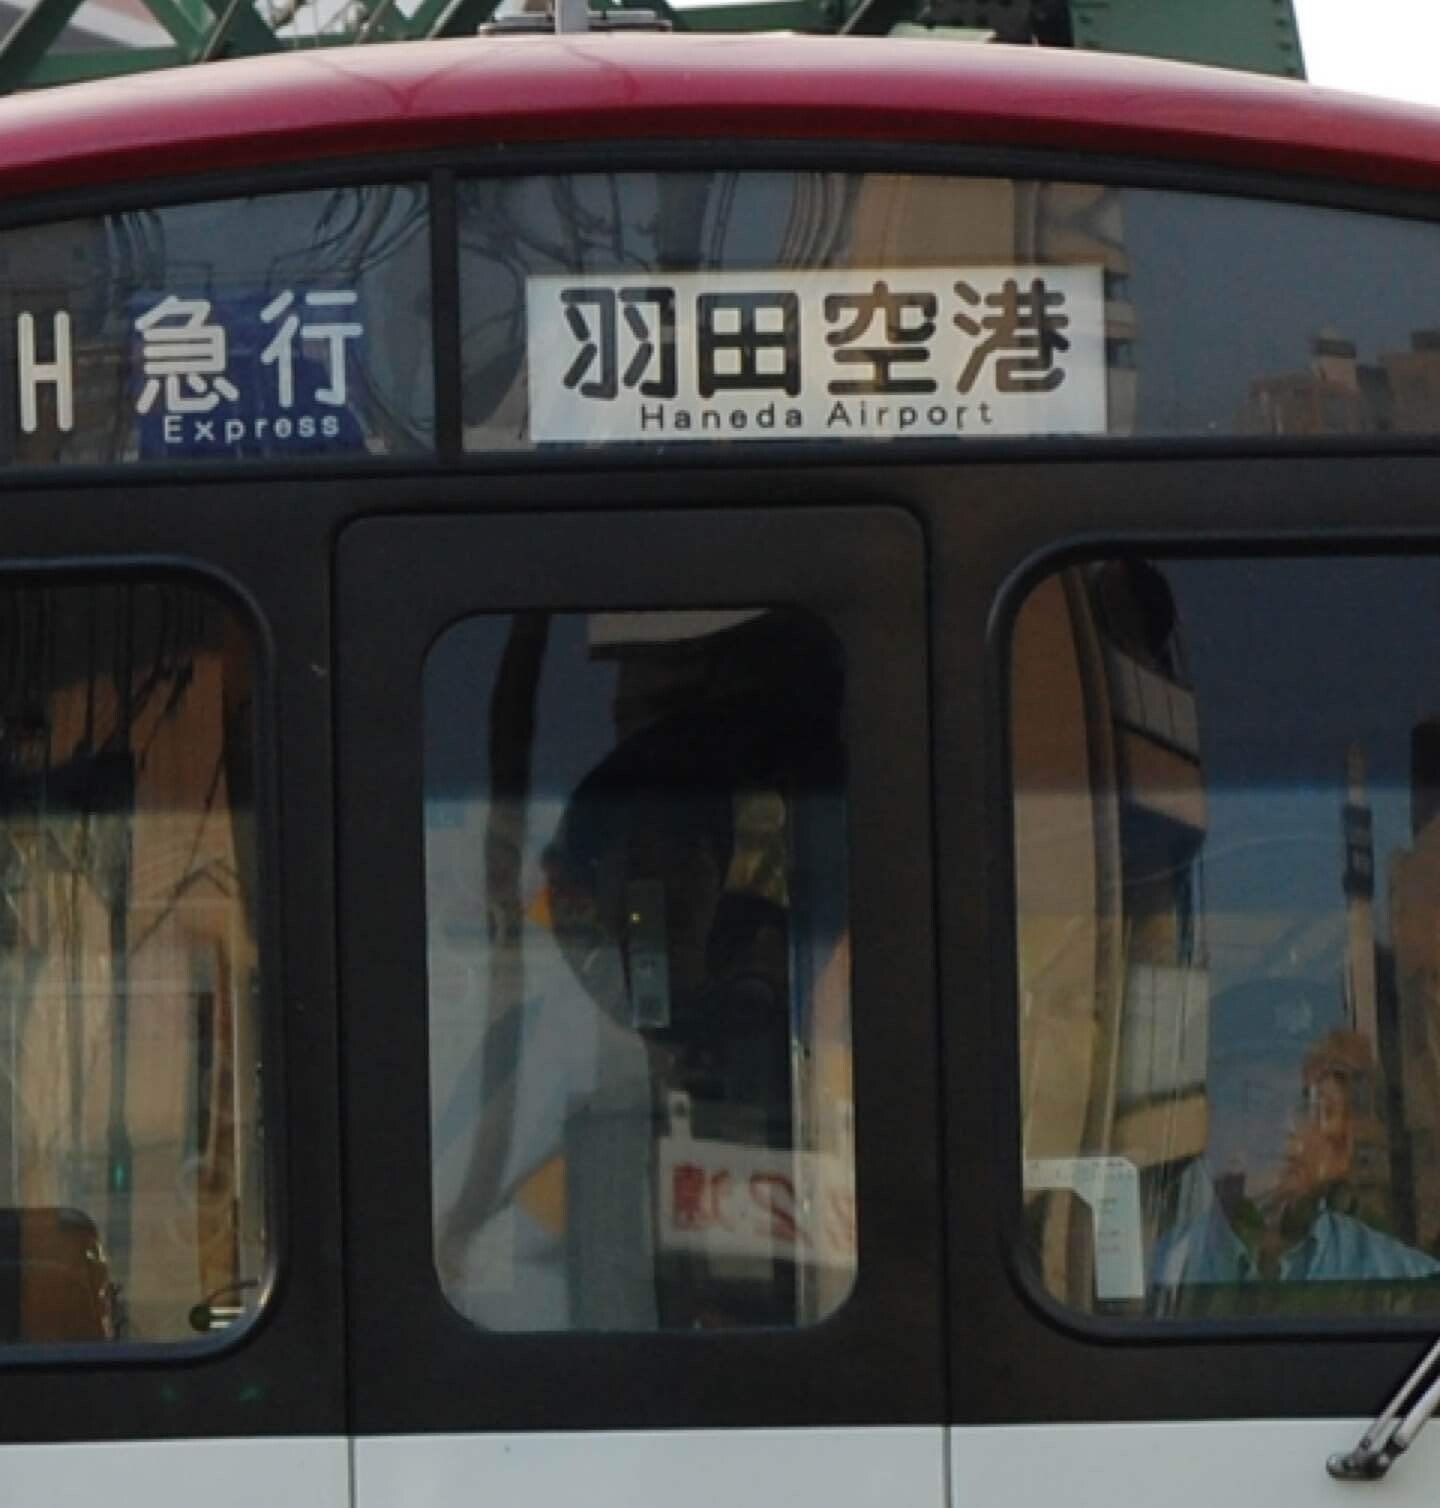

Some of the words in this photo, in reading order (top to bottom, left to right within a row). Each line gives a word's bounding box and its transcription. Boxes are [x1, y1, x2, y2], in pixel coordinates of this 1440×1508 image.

[134, 289, 364, 415] 急行
[559, 277, 1071, 400] 羽田空港
[163, 413, 341, 446] Express
[641, 401, 804, 431] Haneda
[825, 399, 995, 432] Airport
